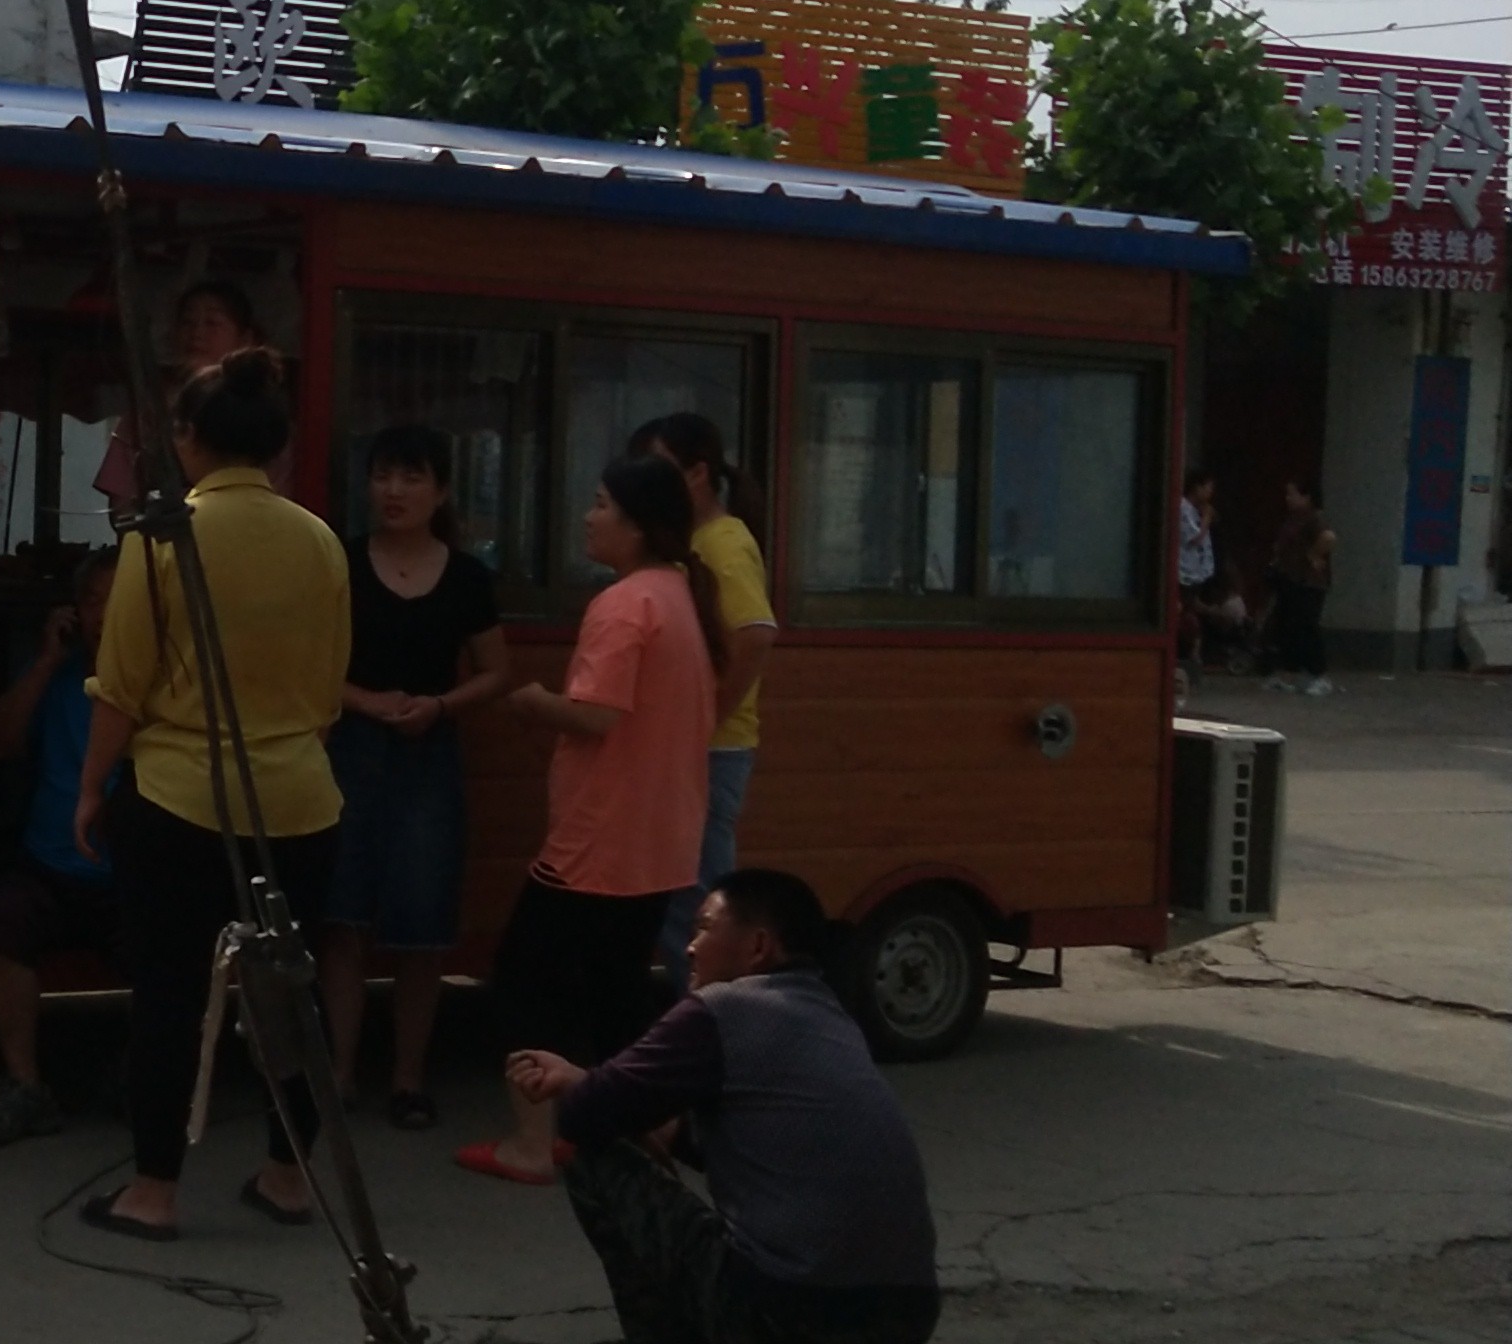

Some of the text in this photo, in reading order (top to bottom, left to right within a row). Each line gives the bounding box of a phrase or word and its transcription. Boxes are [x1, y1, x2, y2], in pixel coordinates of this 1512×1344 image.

[1391, 227, 1497, 264] 安装维修
[1360, 265, 1496, 291] 15863228767
